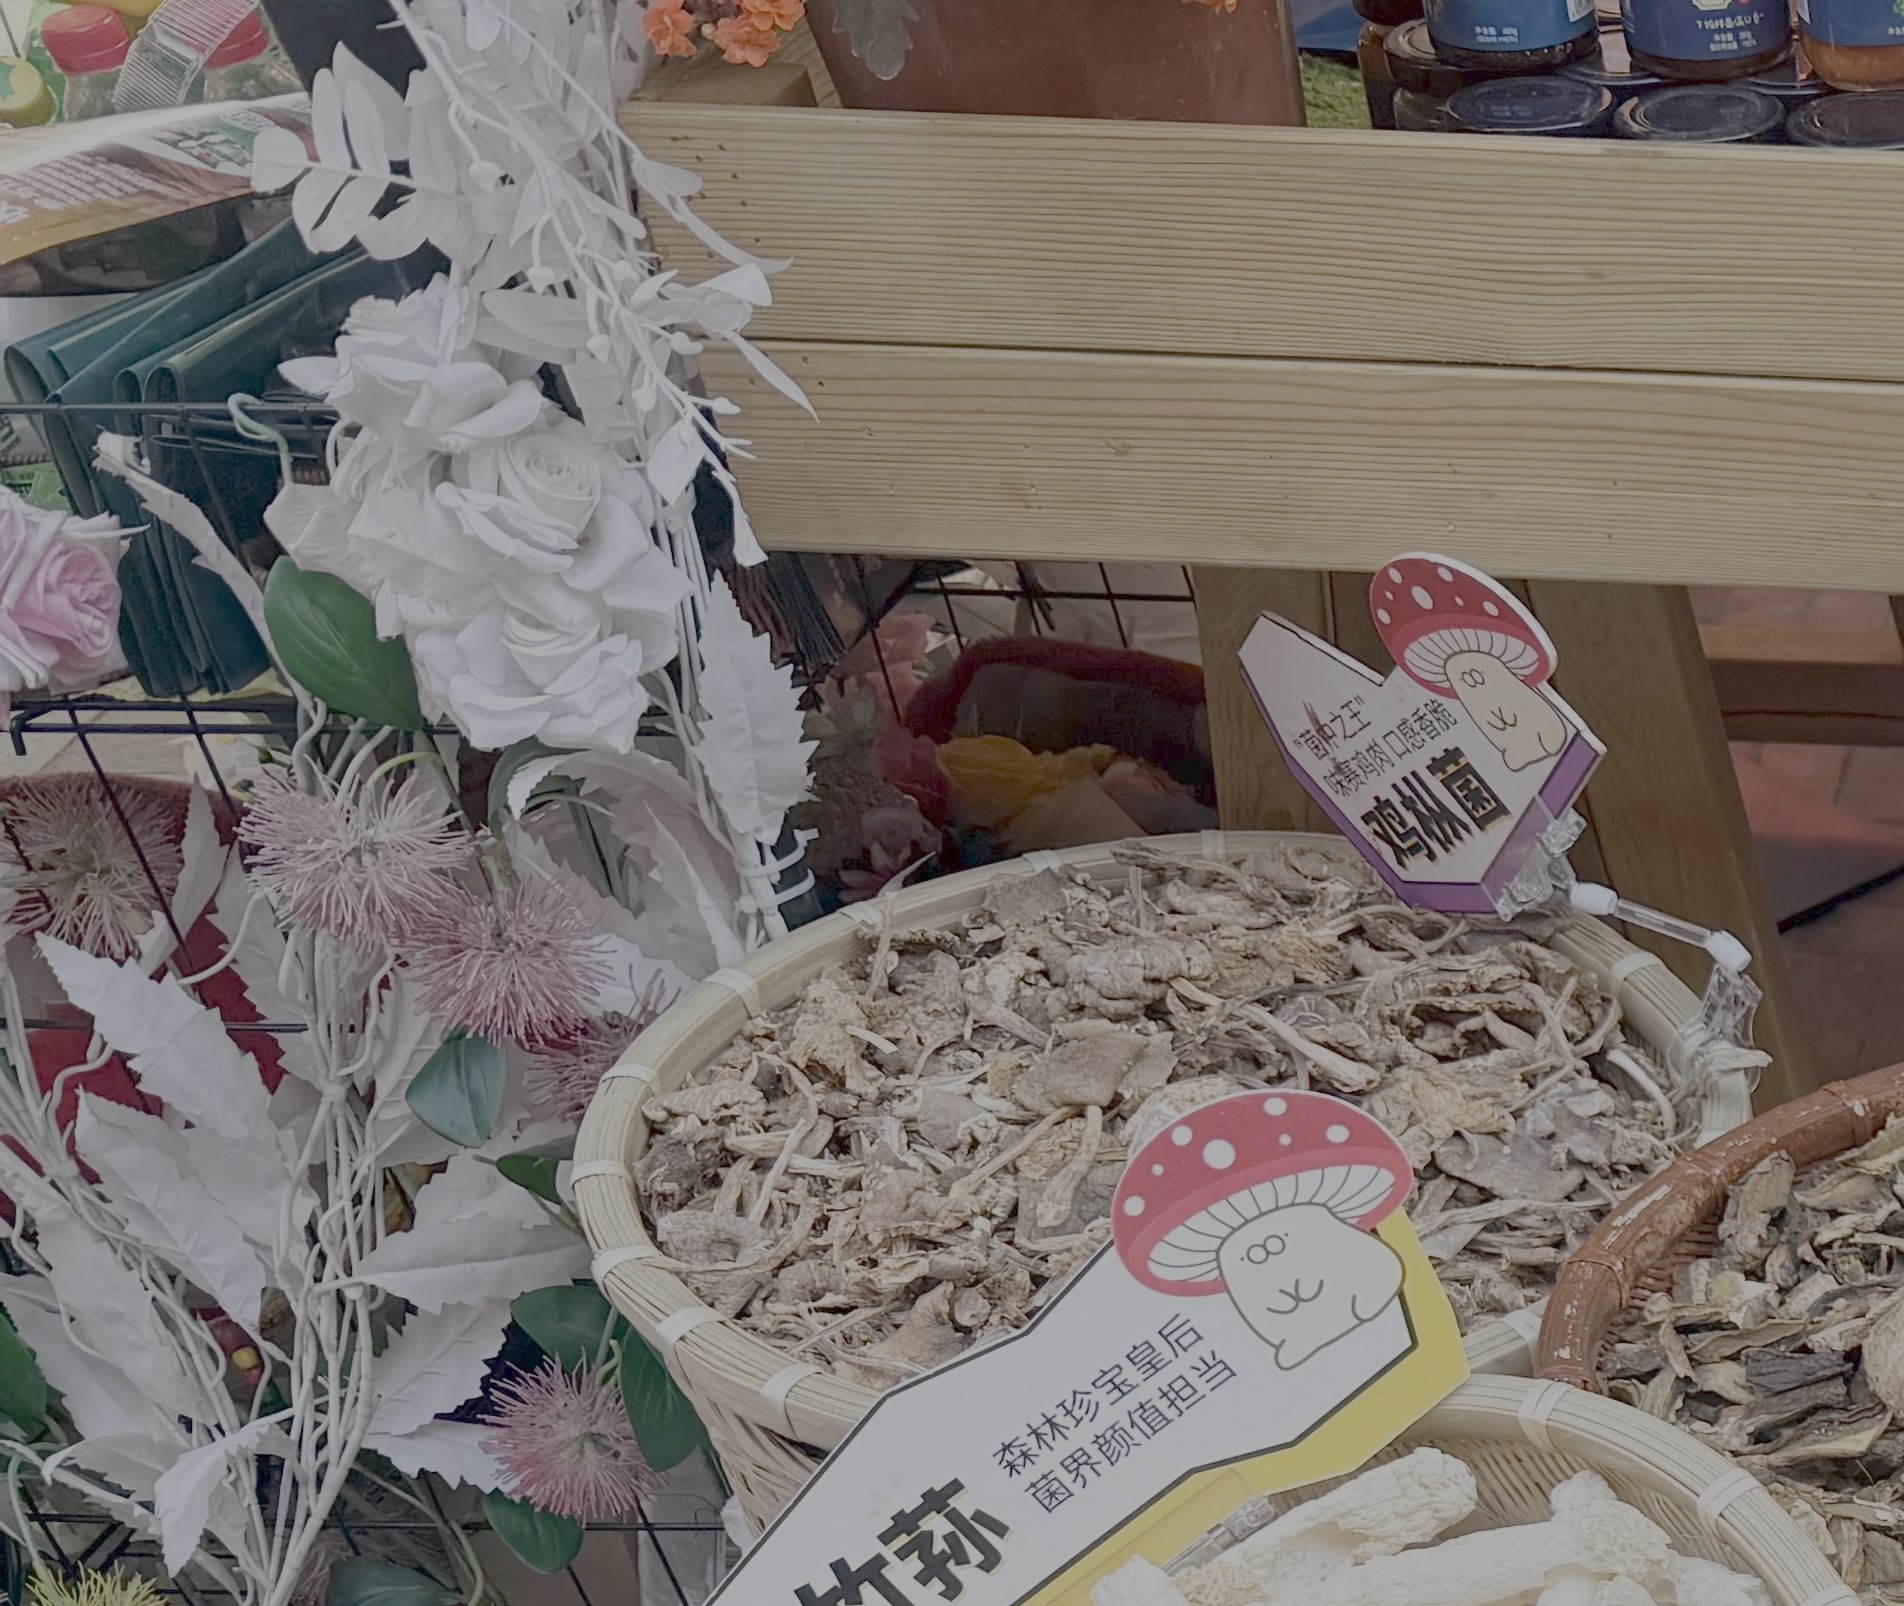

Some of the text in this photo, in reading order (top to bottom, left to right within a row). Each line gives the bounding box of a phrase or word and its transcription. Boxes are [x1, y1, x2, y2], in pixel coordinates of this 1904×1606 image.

[1383, 699, 1458, 760] 口感香脆
[1360, 747, 1512, 870] 鸡枞菌
[991, 1312, 1205, 1478] 森林珍宝皇后
[1024, 1353, 1238, 1514] 菌界颜值担当
